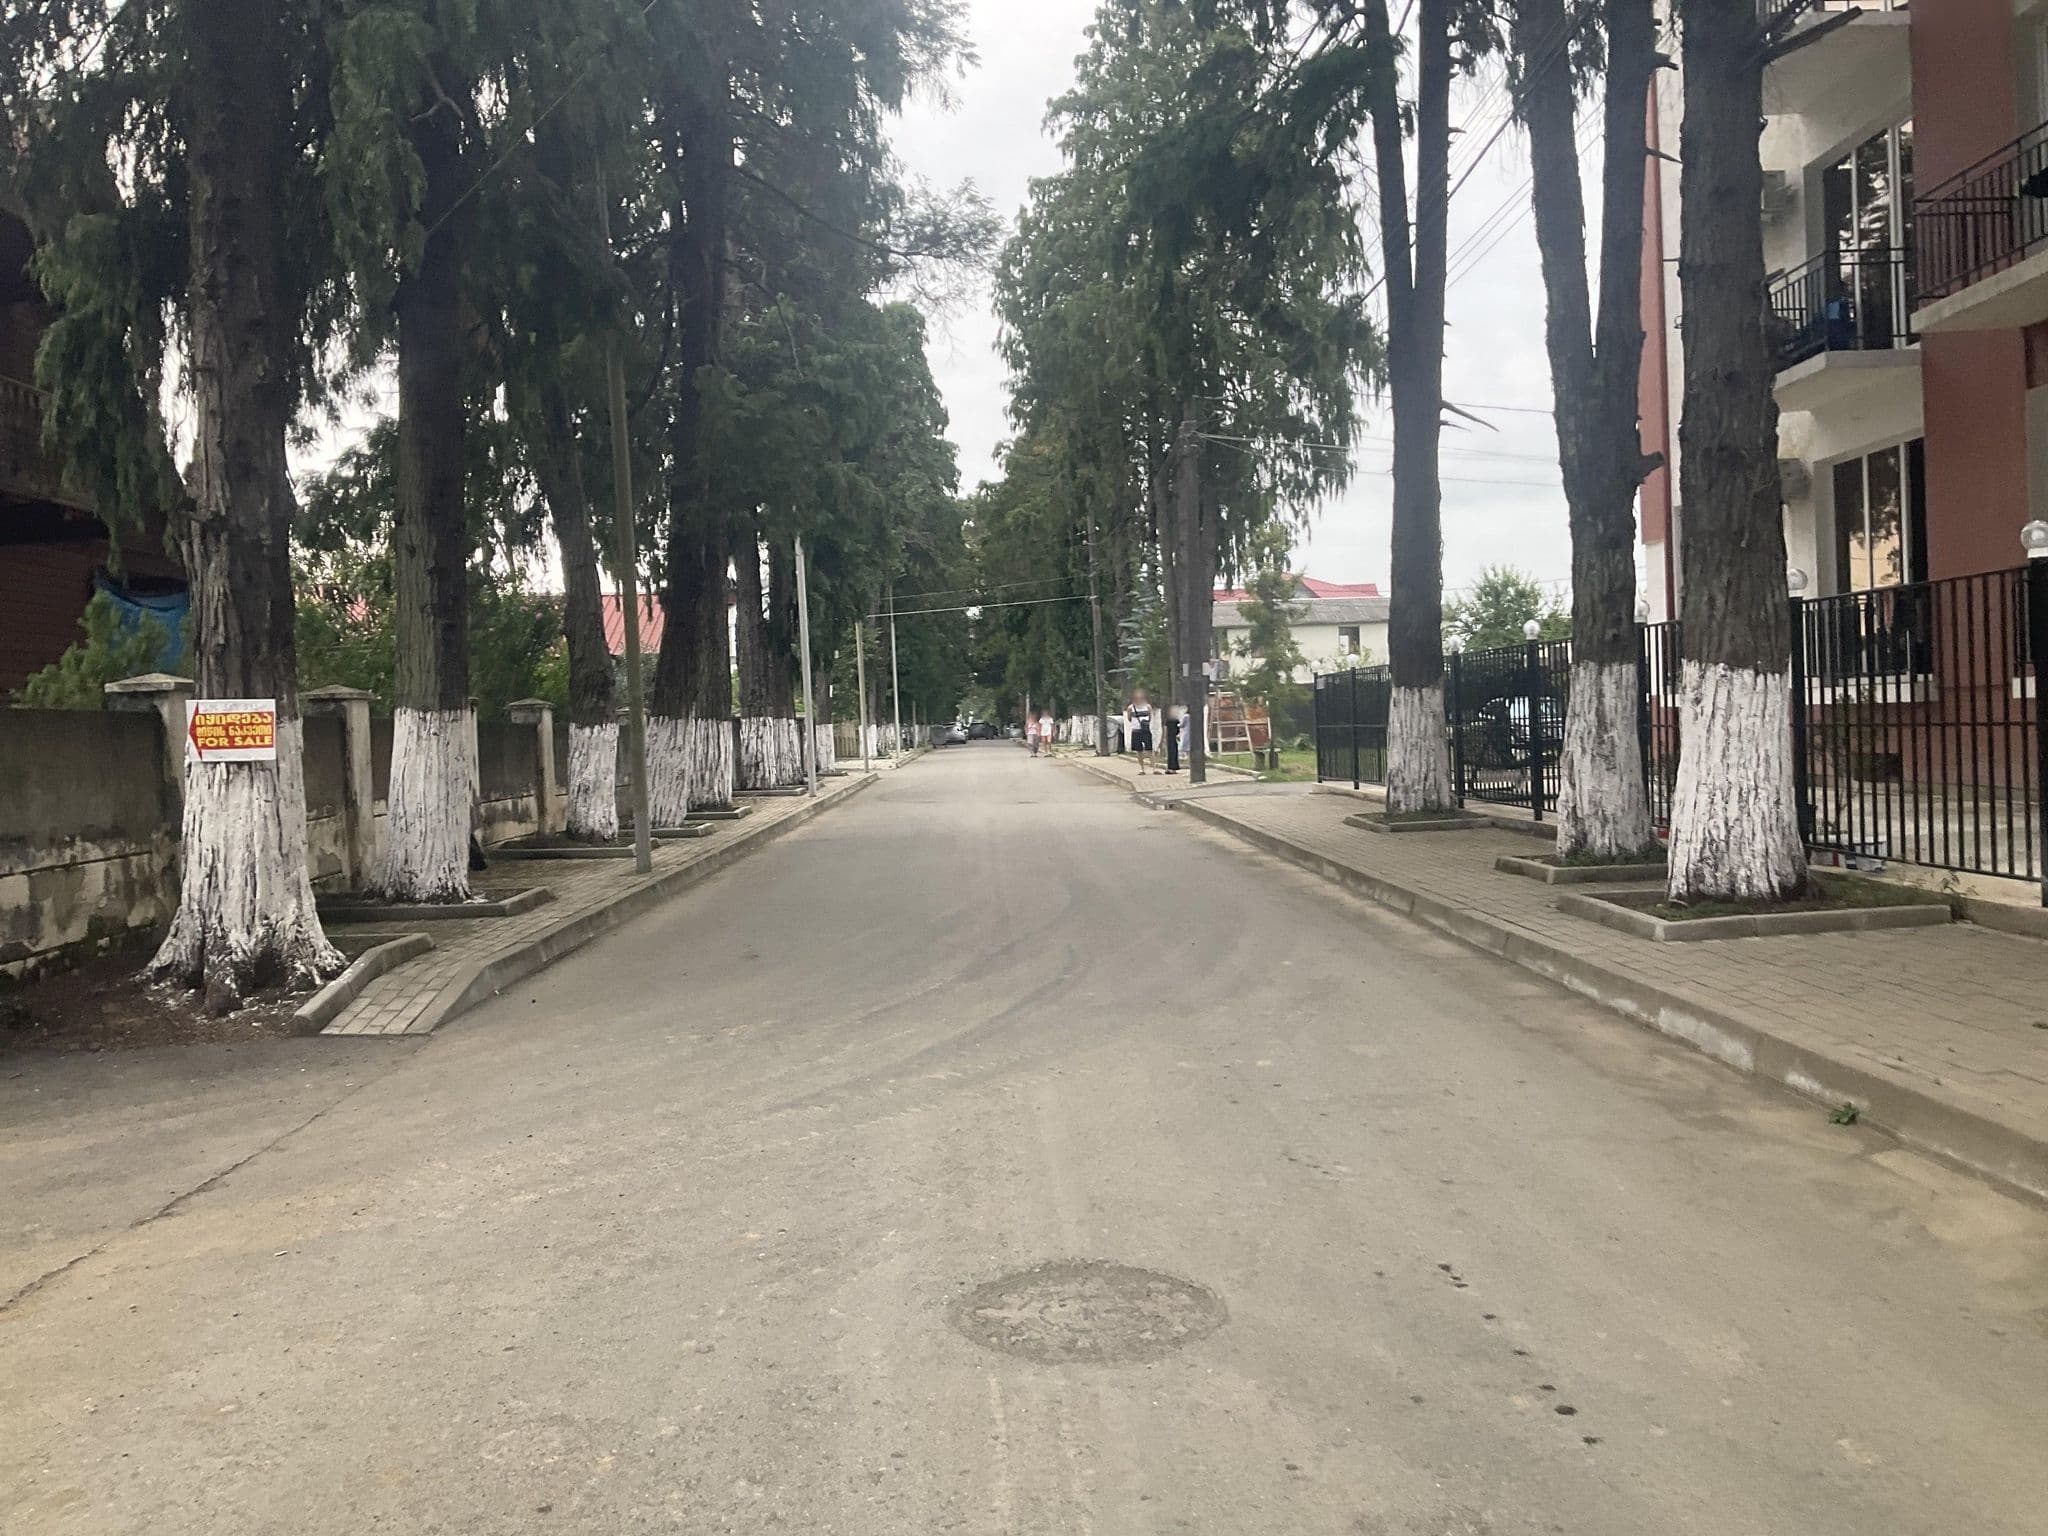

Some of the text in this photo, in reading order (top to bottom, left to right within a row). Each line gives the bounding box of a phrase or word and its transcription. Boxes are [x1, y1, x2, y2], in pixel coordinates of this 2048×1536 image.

[195, 713, 273, 726] იყიდება
[197, 736, 273, 747] FOR SALE
